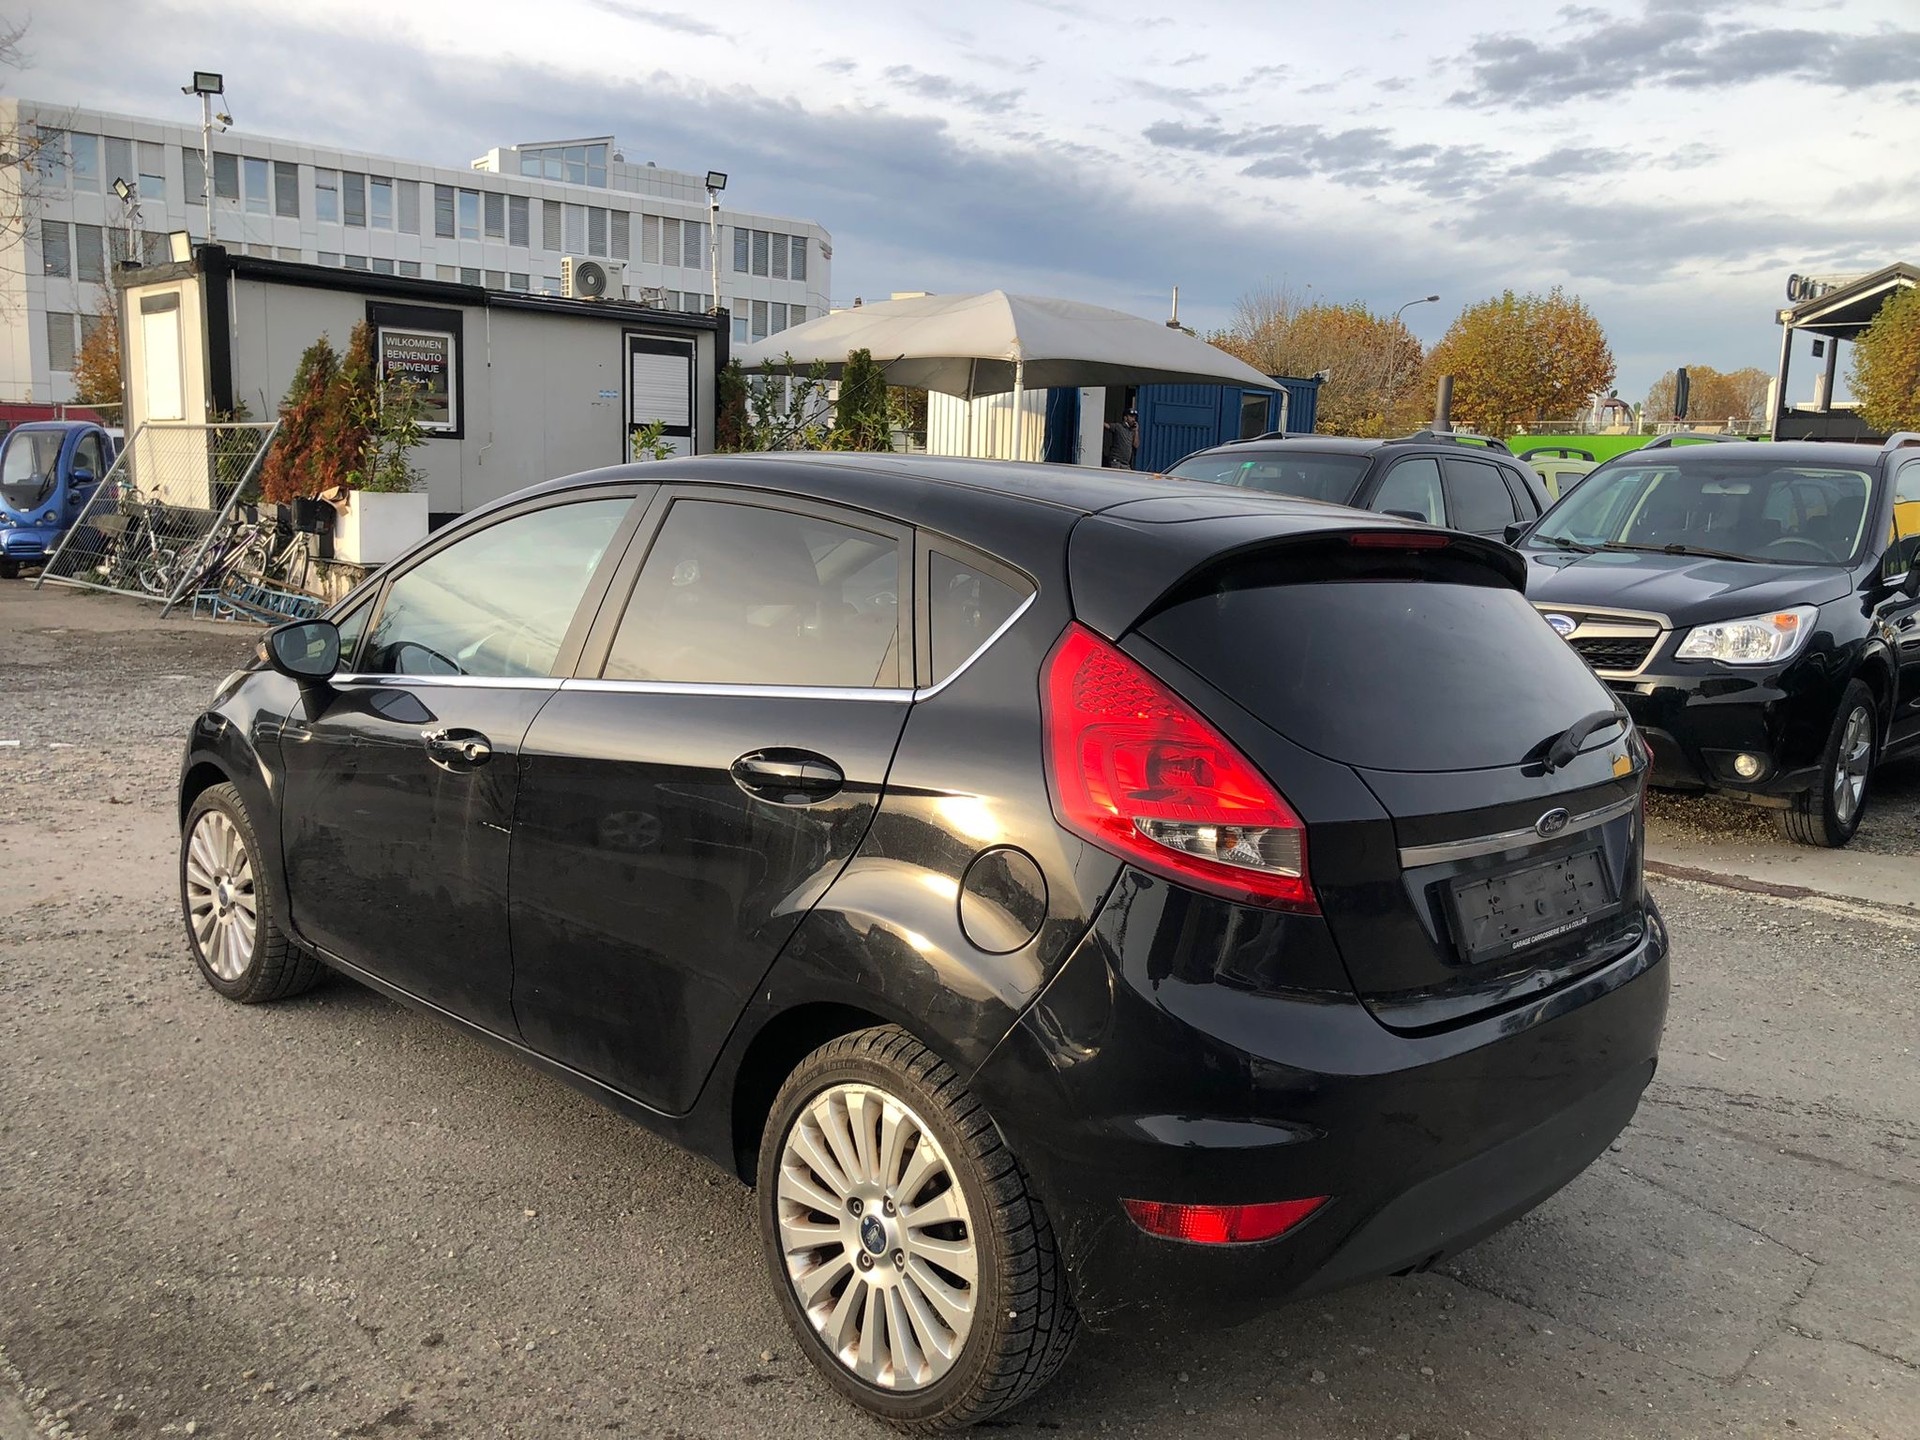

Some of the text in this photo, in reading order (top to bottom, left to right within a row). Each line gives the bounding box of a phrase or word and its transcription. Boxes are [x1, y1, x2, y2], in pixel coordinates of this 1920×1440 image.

[386, 337, 442, 349] WILKOMMEN
[387, 350, 442, 362] BENVENUTO
[388, 361, 440, 373] BIENVENUE
[1512, 937, 1531, 949] GARAGE
[1531, 927, 1560, 942] CARROSSERIE
